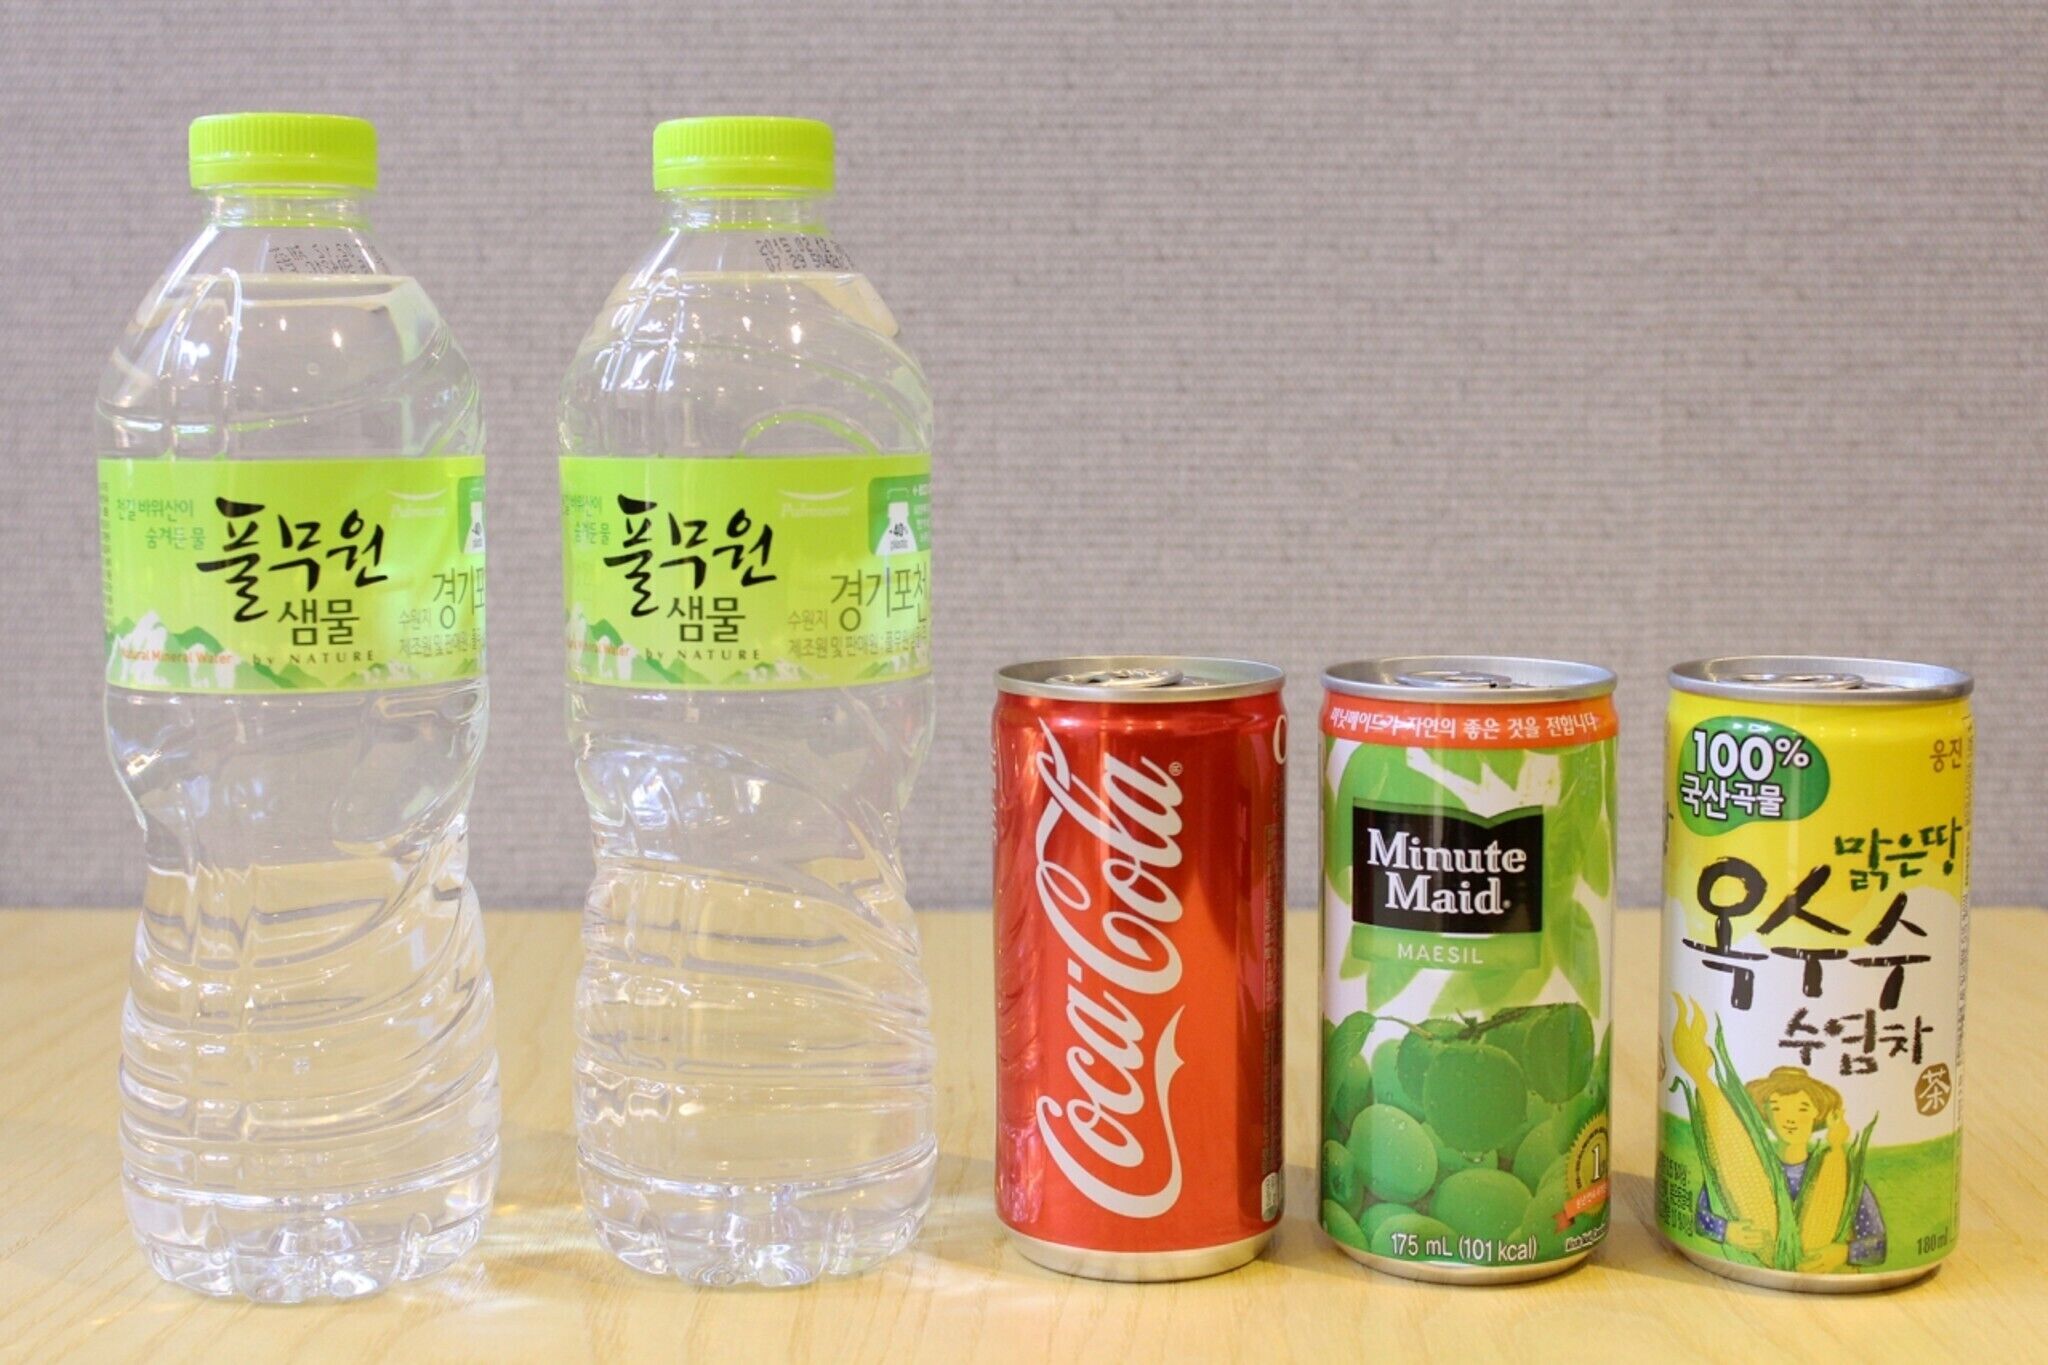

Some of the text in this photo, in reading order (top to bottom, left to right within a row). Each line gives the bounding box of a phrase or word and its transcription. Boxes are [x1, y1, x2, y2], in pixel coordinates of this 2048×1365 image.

[196, 496, 389, 622] 풀무원
[603, 493, 777, 617] 풀무원
[278, 598, 360, 645] 샘물
[667, 596, 746, 642] 샘물
[290, 650, 374, 664] NATURE
[677, 648, 760, 661] NATURE
[1463, 717, 1501, 741] 좋은
[1506, 716, 1541, 740] 것을
[1545, 711, 1598, 738] 전합니다
[1693, 730, 1811, 782] 100%
[1930, 737, 1963, 773] 웅진
[1681, 773, 1784, 820] 국산곡물
[1367, 827, 1527, 874] Minute
[1397, 943, 1483, 964] MAESIL
[1682, 856, 1932, 1011] 옥수수
[1036, 716, 1184, 1219] Coca-Cola
[1778, 1006, 1934, 1077] 수염차
[1918, 1067, 1951, 1113] 茶
[1391, 1233, 1419, 1257] 175
[1425, 1236, 1453, 1257] mL
[1459, 1235, 1493, 1262] (101
[1497, 1234, 1538, 1261] kcal)
